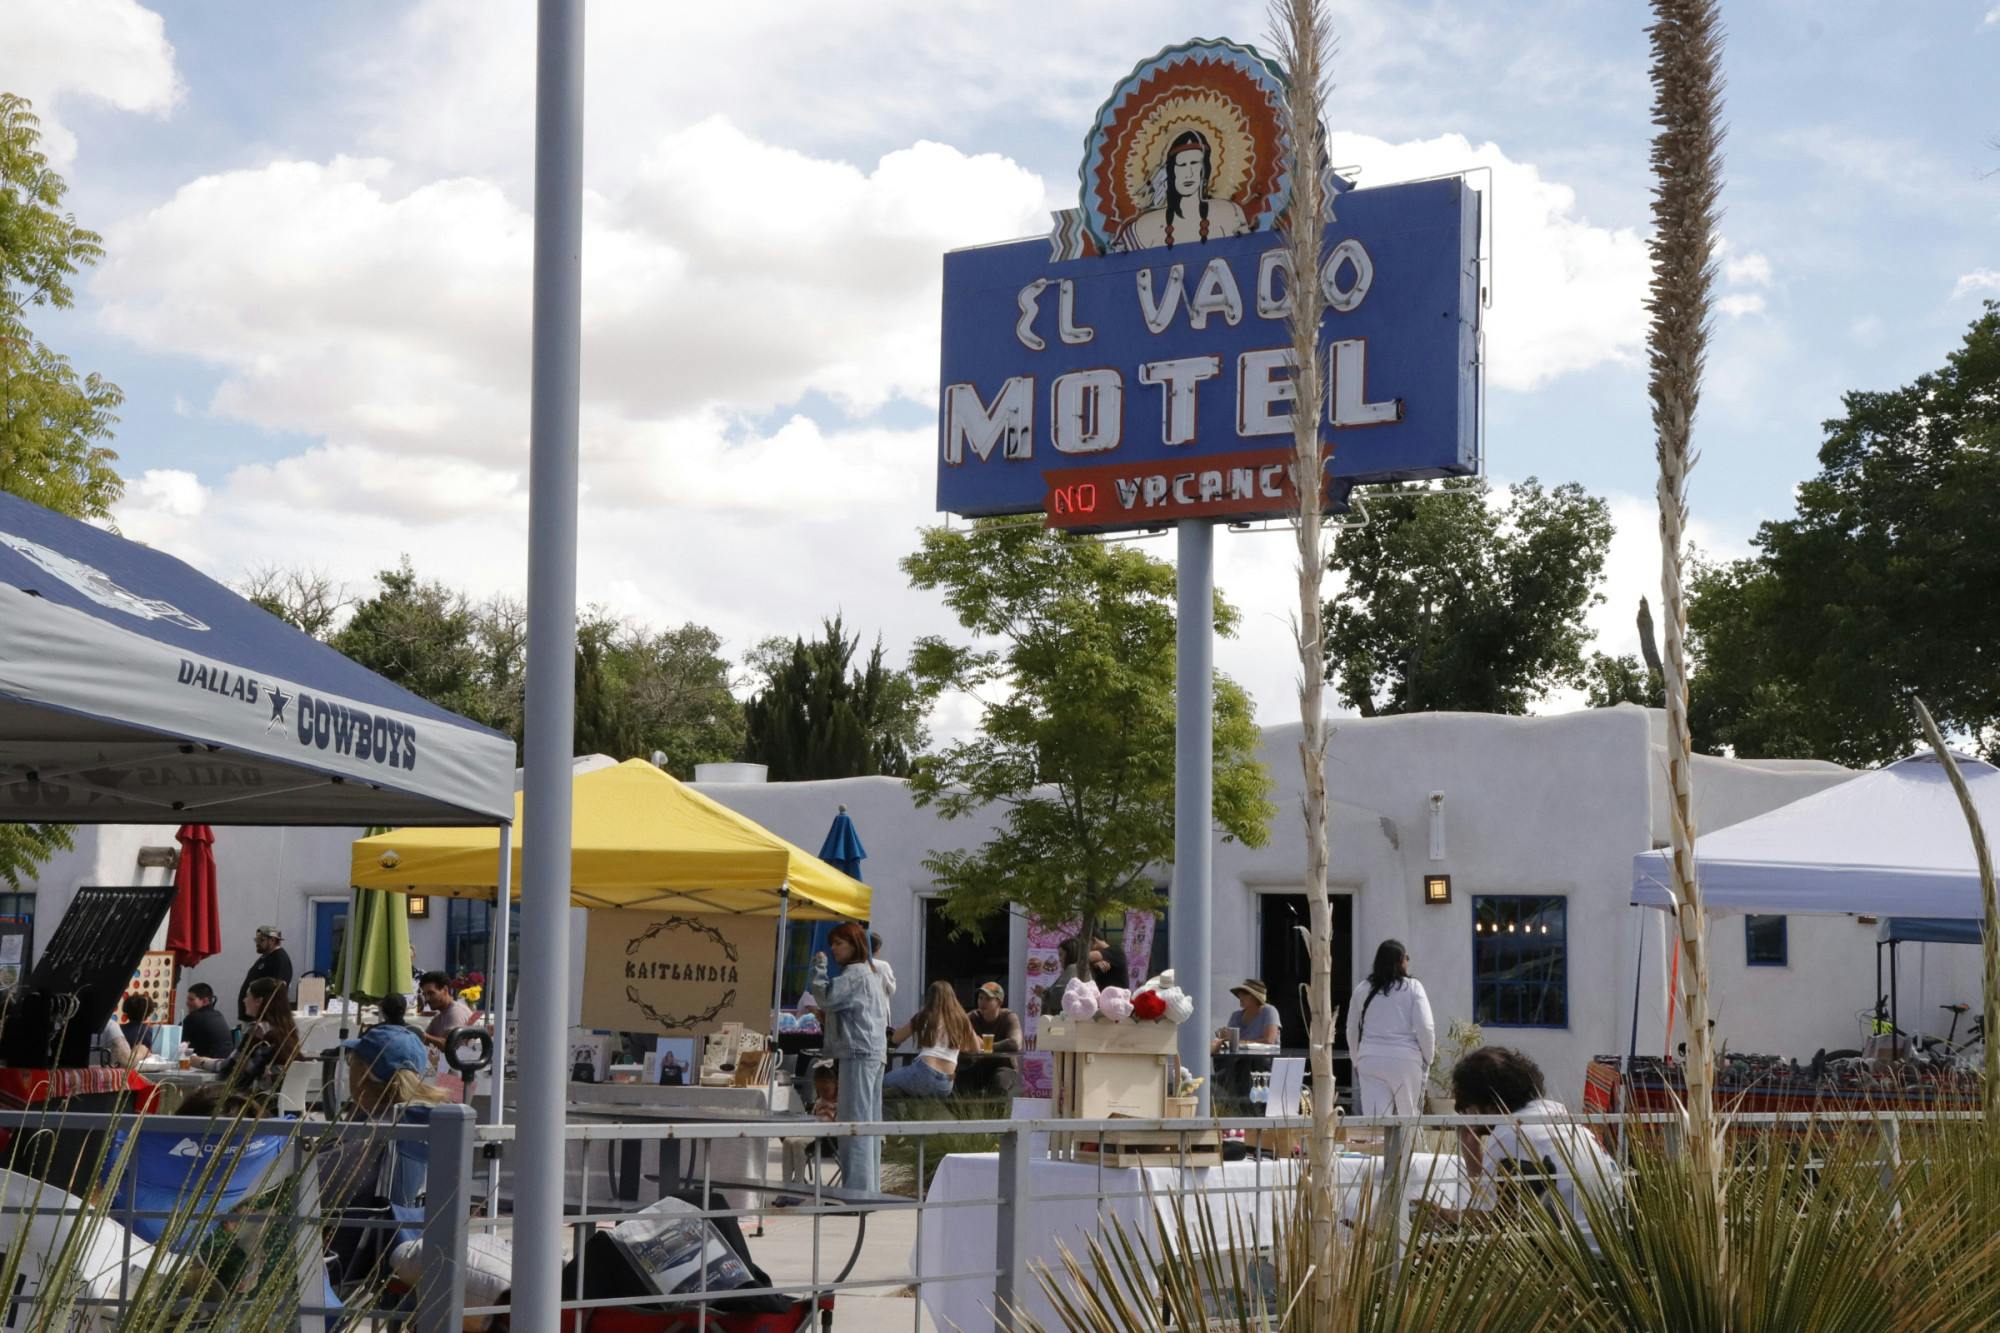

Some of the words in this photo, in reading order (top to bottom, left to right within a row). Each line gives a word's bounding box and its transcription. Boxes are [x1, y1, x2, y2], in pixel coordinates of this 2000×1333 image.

[1016, 277, 1094, 351] EL
[1136, 238, 1374, 335] VADO
[944, 338, 1404, 465] MOTEL
[1054, 483, 1096, 514] NO
[177, 658, 258, 704] DALLAS
[297, 692, 417, 771] COWBOYS
[625, 960, 739, 983] KAITLANDIA
